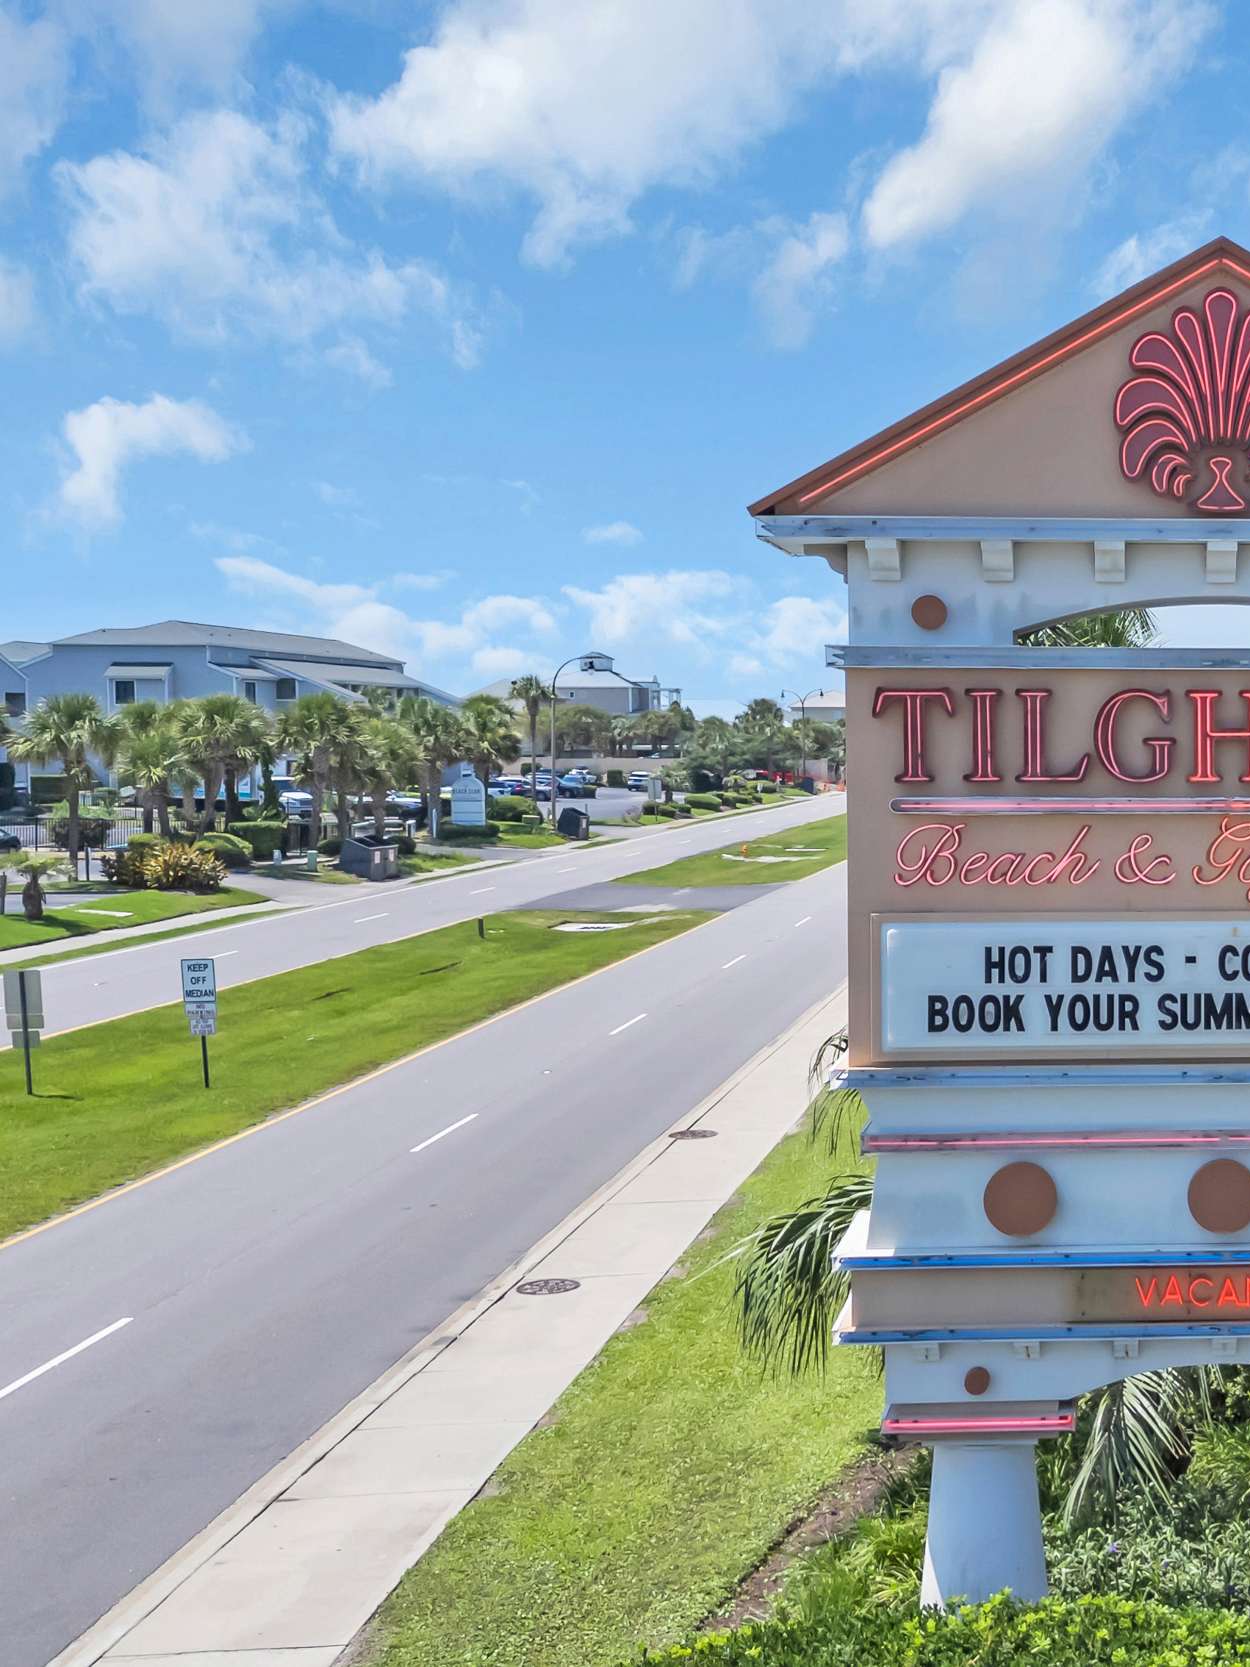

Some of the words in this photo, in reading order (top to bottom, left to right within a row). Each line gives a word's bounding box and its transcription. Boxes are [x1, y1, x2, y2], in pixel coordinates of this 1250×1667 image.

[894, 822, 1101, 887] Beach
[1114, 833, 1177, 885] &
[187, 963, 209, 972] KEEP
[984, 945, 1053, 984] HOT
[1070, 945, 1165, 984] DAYS
[190, 976, 207, 985] OFF
[185, 989, 214, 998] MEDIAN
[927, 994, 1025, 1033] BOOK
[1044, 993, 1140, 1032] YOUR
